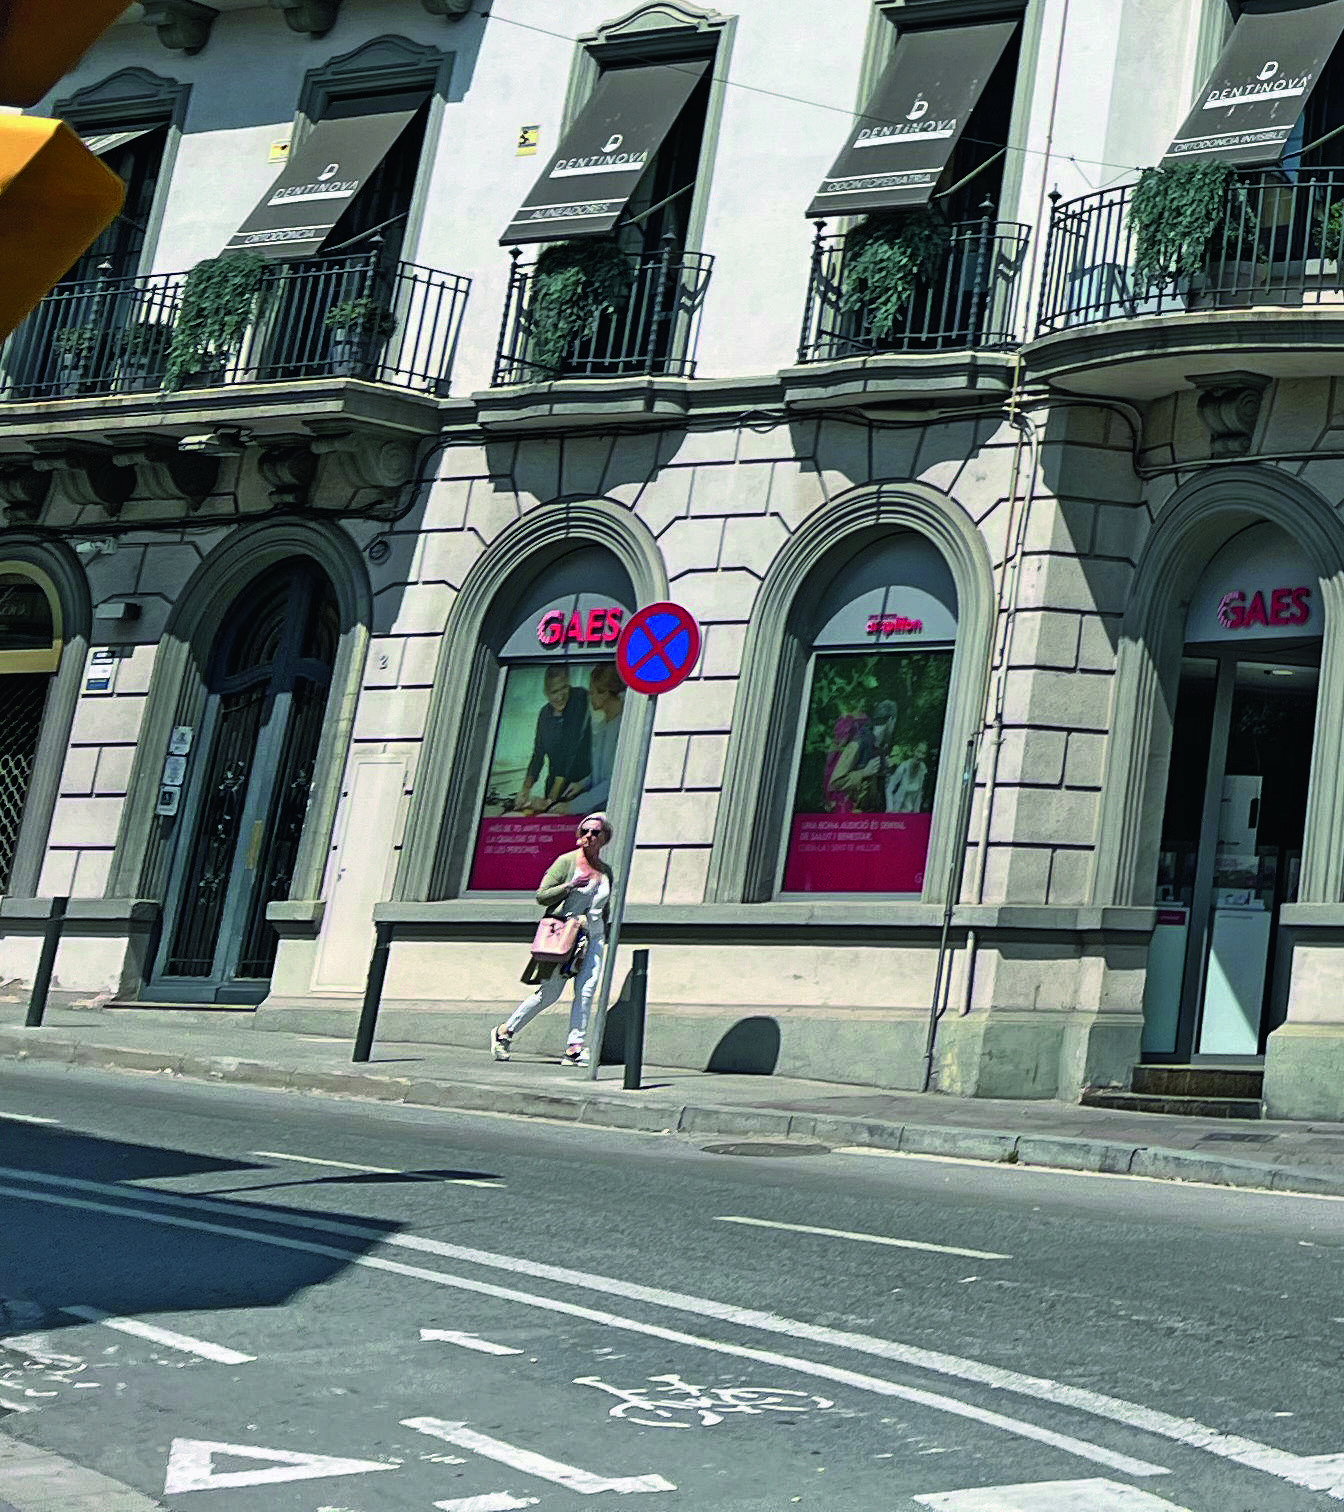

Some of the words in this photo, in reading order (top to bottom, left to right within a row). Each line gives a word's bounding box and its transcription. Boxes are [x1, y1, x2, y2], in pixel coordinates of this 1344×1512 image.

[858, 118, 957, 140] DENTINOVA
[1174, 136, 1240, 153] ORTODONCIA
[1240, 131, 1286, 144] INVISIBLE
[554, 150, 649, 171] DENTINOVA
[272, 179, 359, 200] DENTINOVA
[827, 173, 932, 192] ODONTOPEDIATRIA
[530, 202, 610, 219] ALINEADORES
[1216, 587, 1310, 629] GAES
[536, 607, 623, 644] GAES
